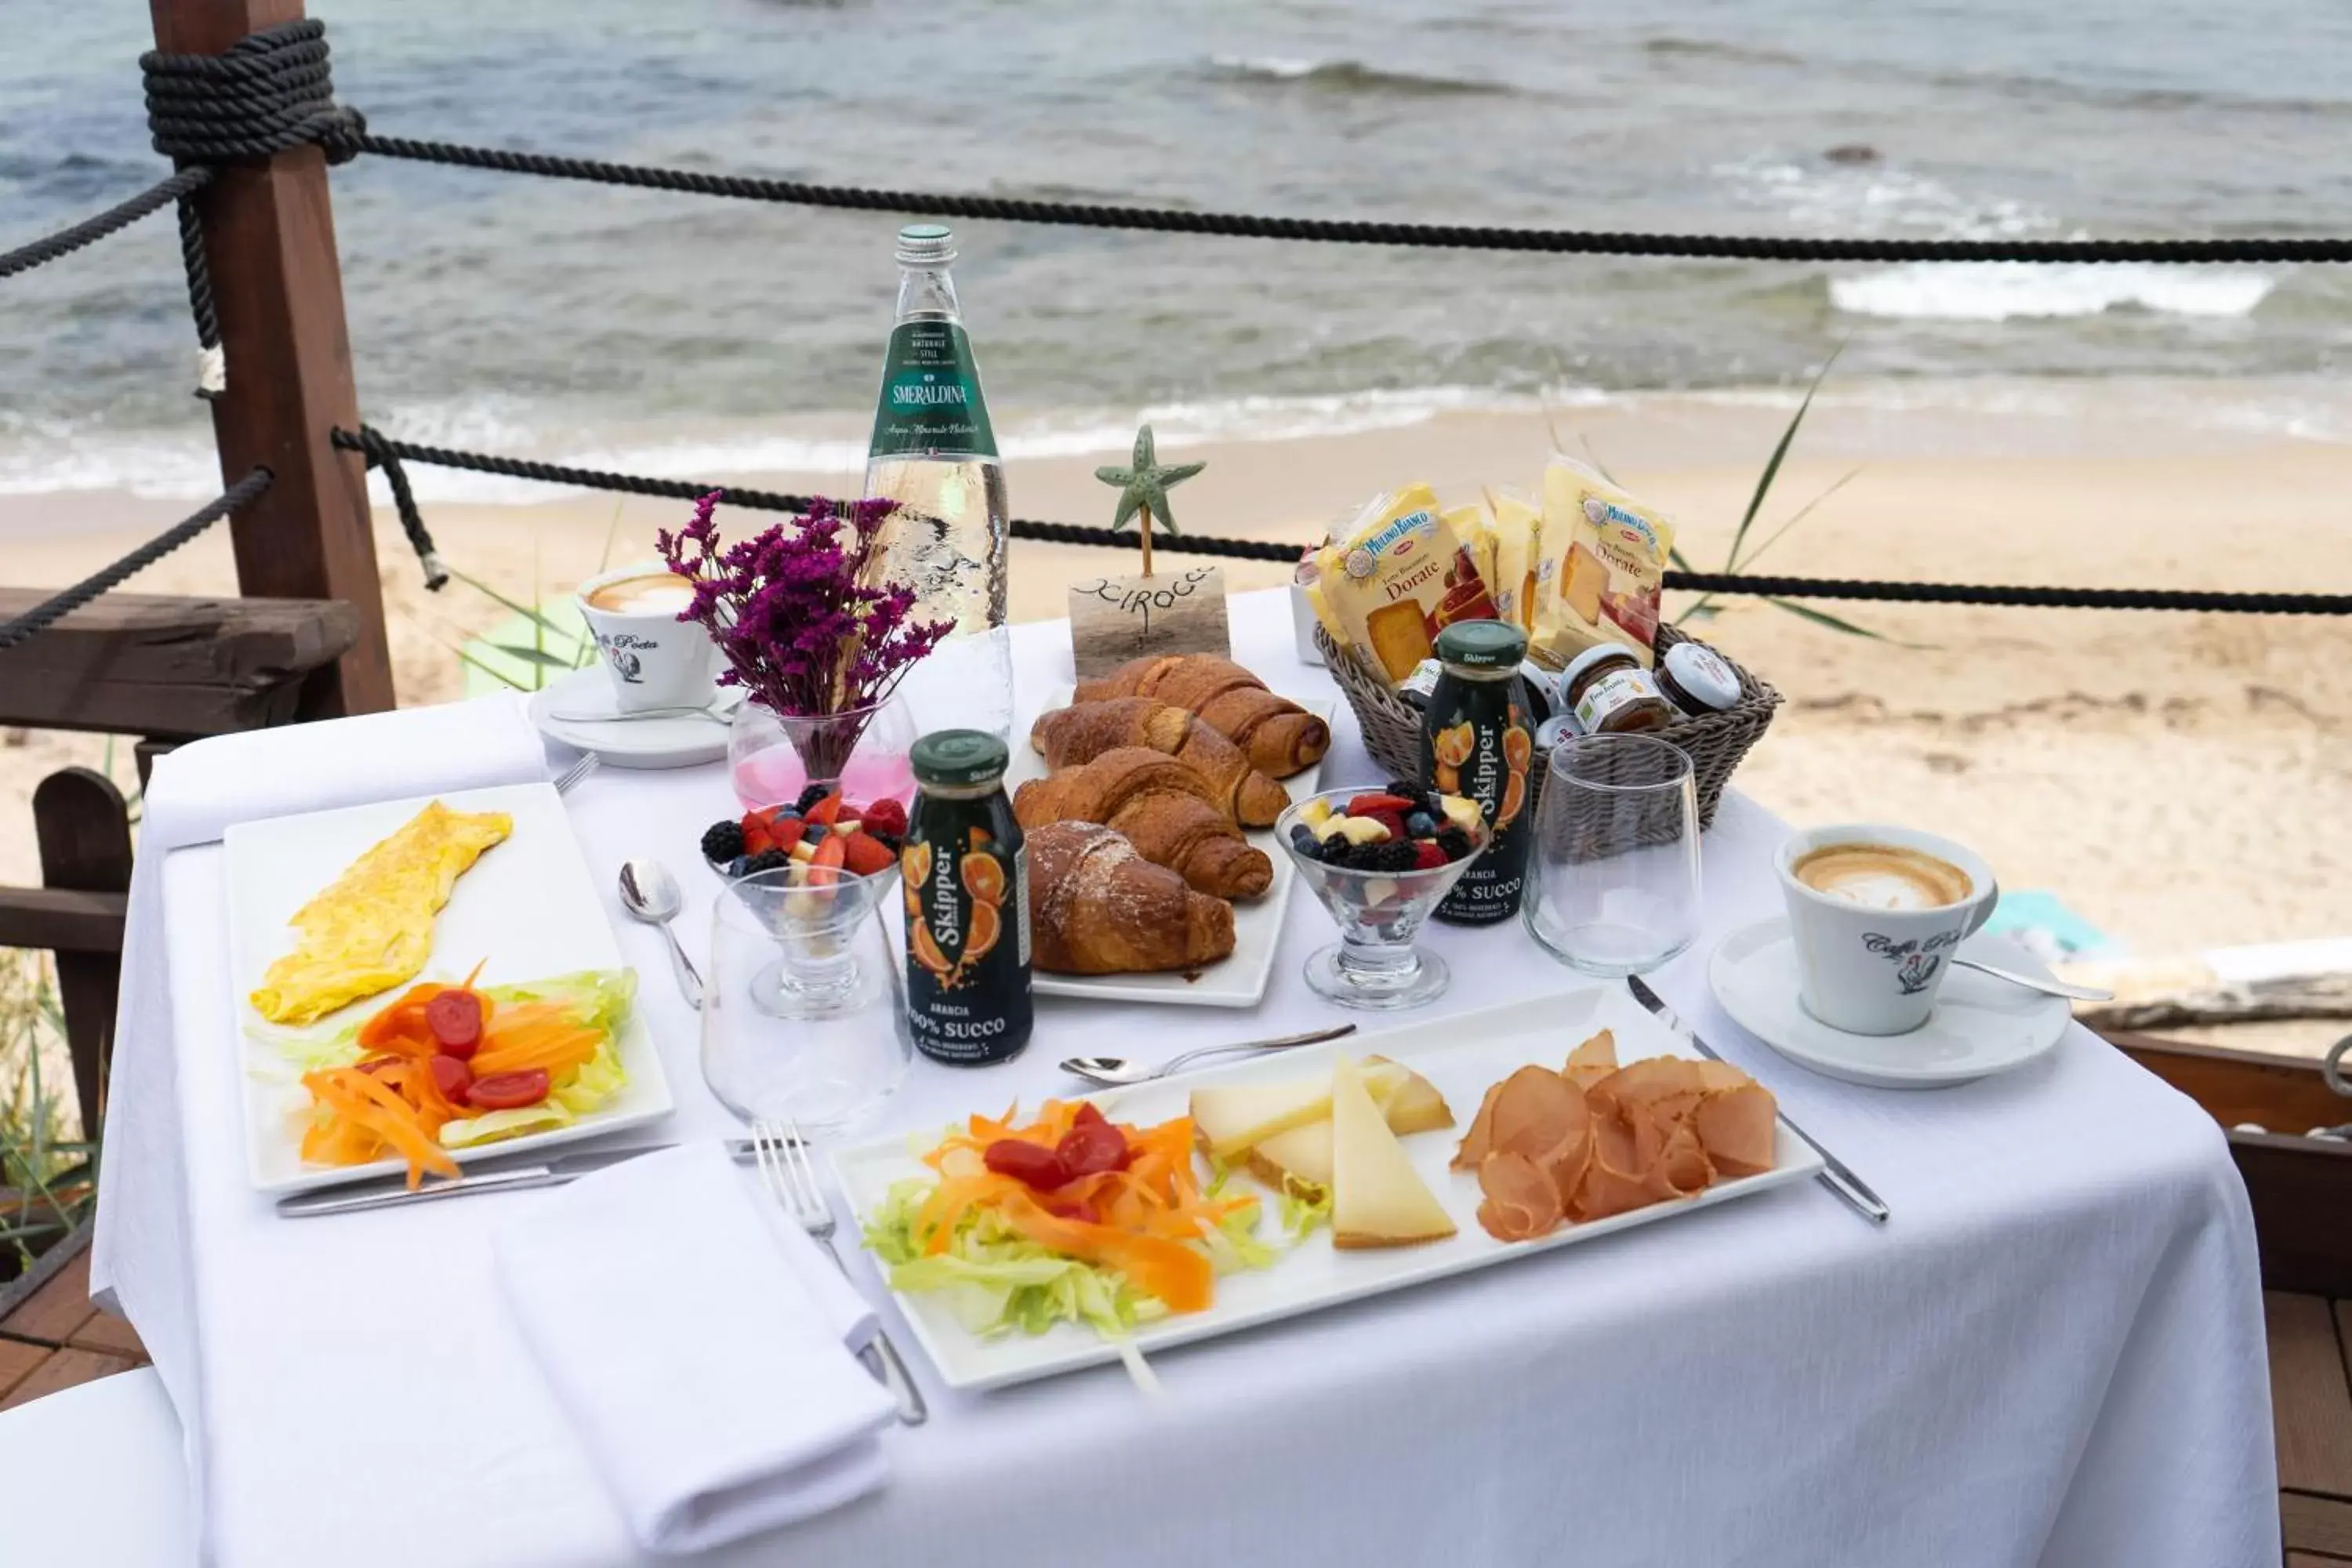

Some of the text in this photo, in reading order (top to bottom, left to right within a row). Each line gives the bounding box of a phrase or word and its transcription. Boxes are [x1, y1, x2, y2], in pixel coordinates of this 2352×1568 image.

[893, 385, 967, 405] SMERALDINA
[1385, 562, 1441, 601] Dorate
[932, 846, 959, 946] Skipper
[1472, 877, 1520, 899] SUCCO
[930, 1003, 971, 1017] ARANCIA
[944, 1017, 1005, 1039] SUCCO
